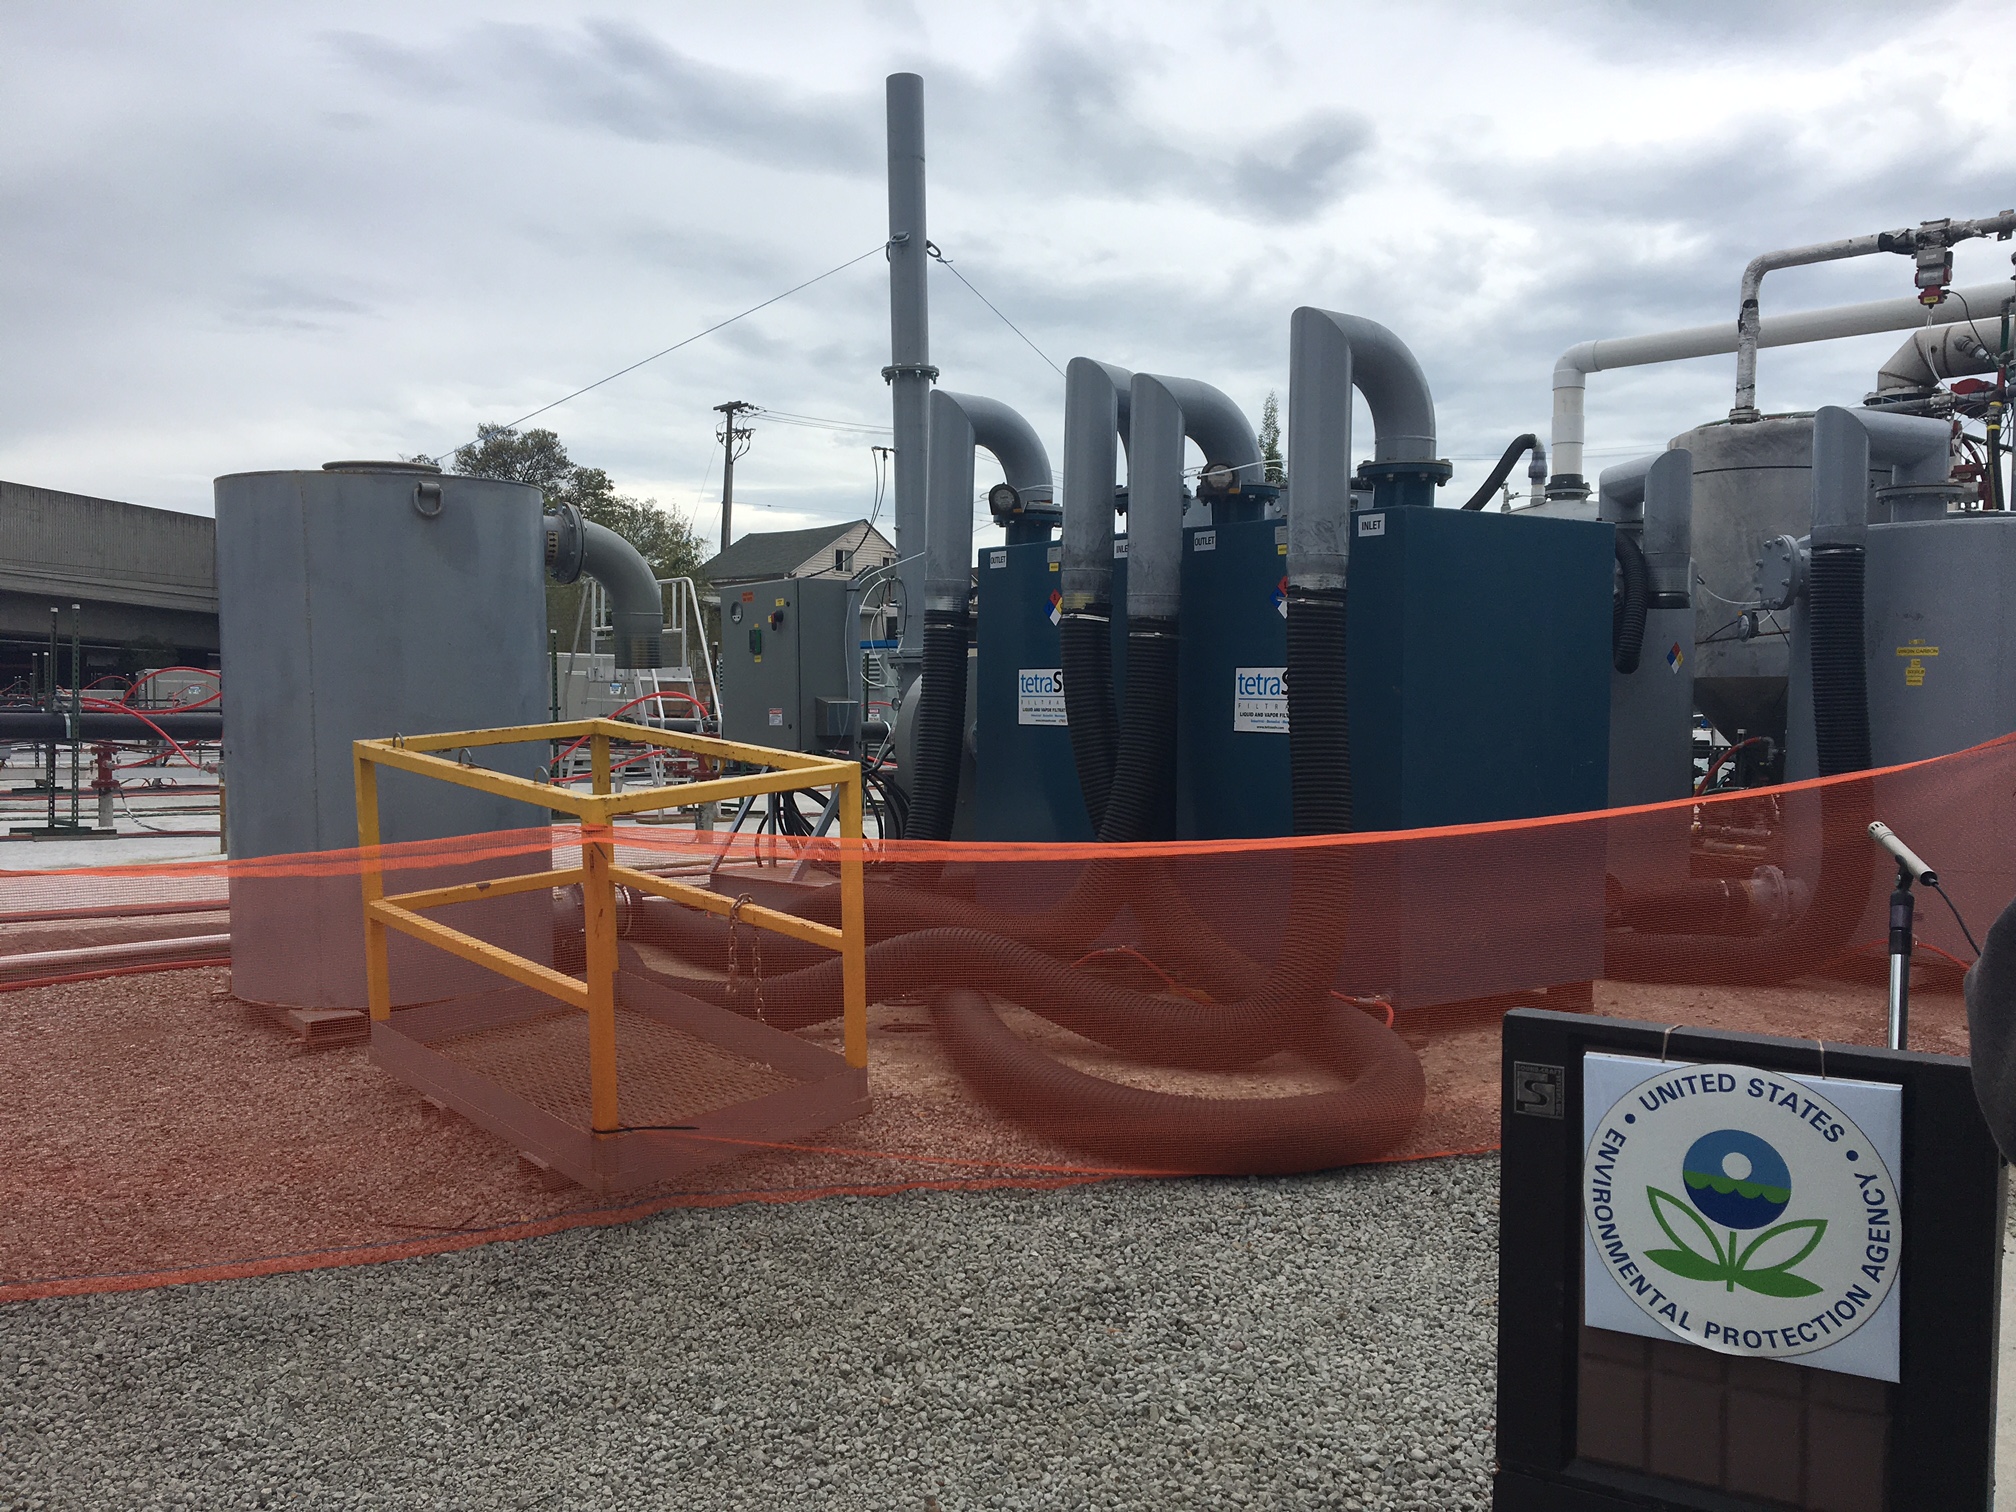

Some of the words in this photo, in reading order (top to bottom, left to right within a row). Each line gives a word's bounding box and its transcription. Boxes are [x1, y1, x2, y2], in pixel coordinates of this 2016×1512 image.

[1361, 520, 1381, 530] INLET
[1194, 536, 1215, 546] OUTLET
[990, 555, 1006, 564] OUTLET
[1638, 1073, 1737, 1112] UNITED
[1747, 1077, 1845, 1144] STATES
[1592, 1127, 1691, 1331] ENVIRONMENTAL
[1703, 1284, 1873, 1349] PROTECTION
[1854, 1172, 1891, 1284] AGENCY
